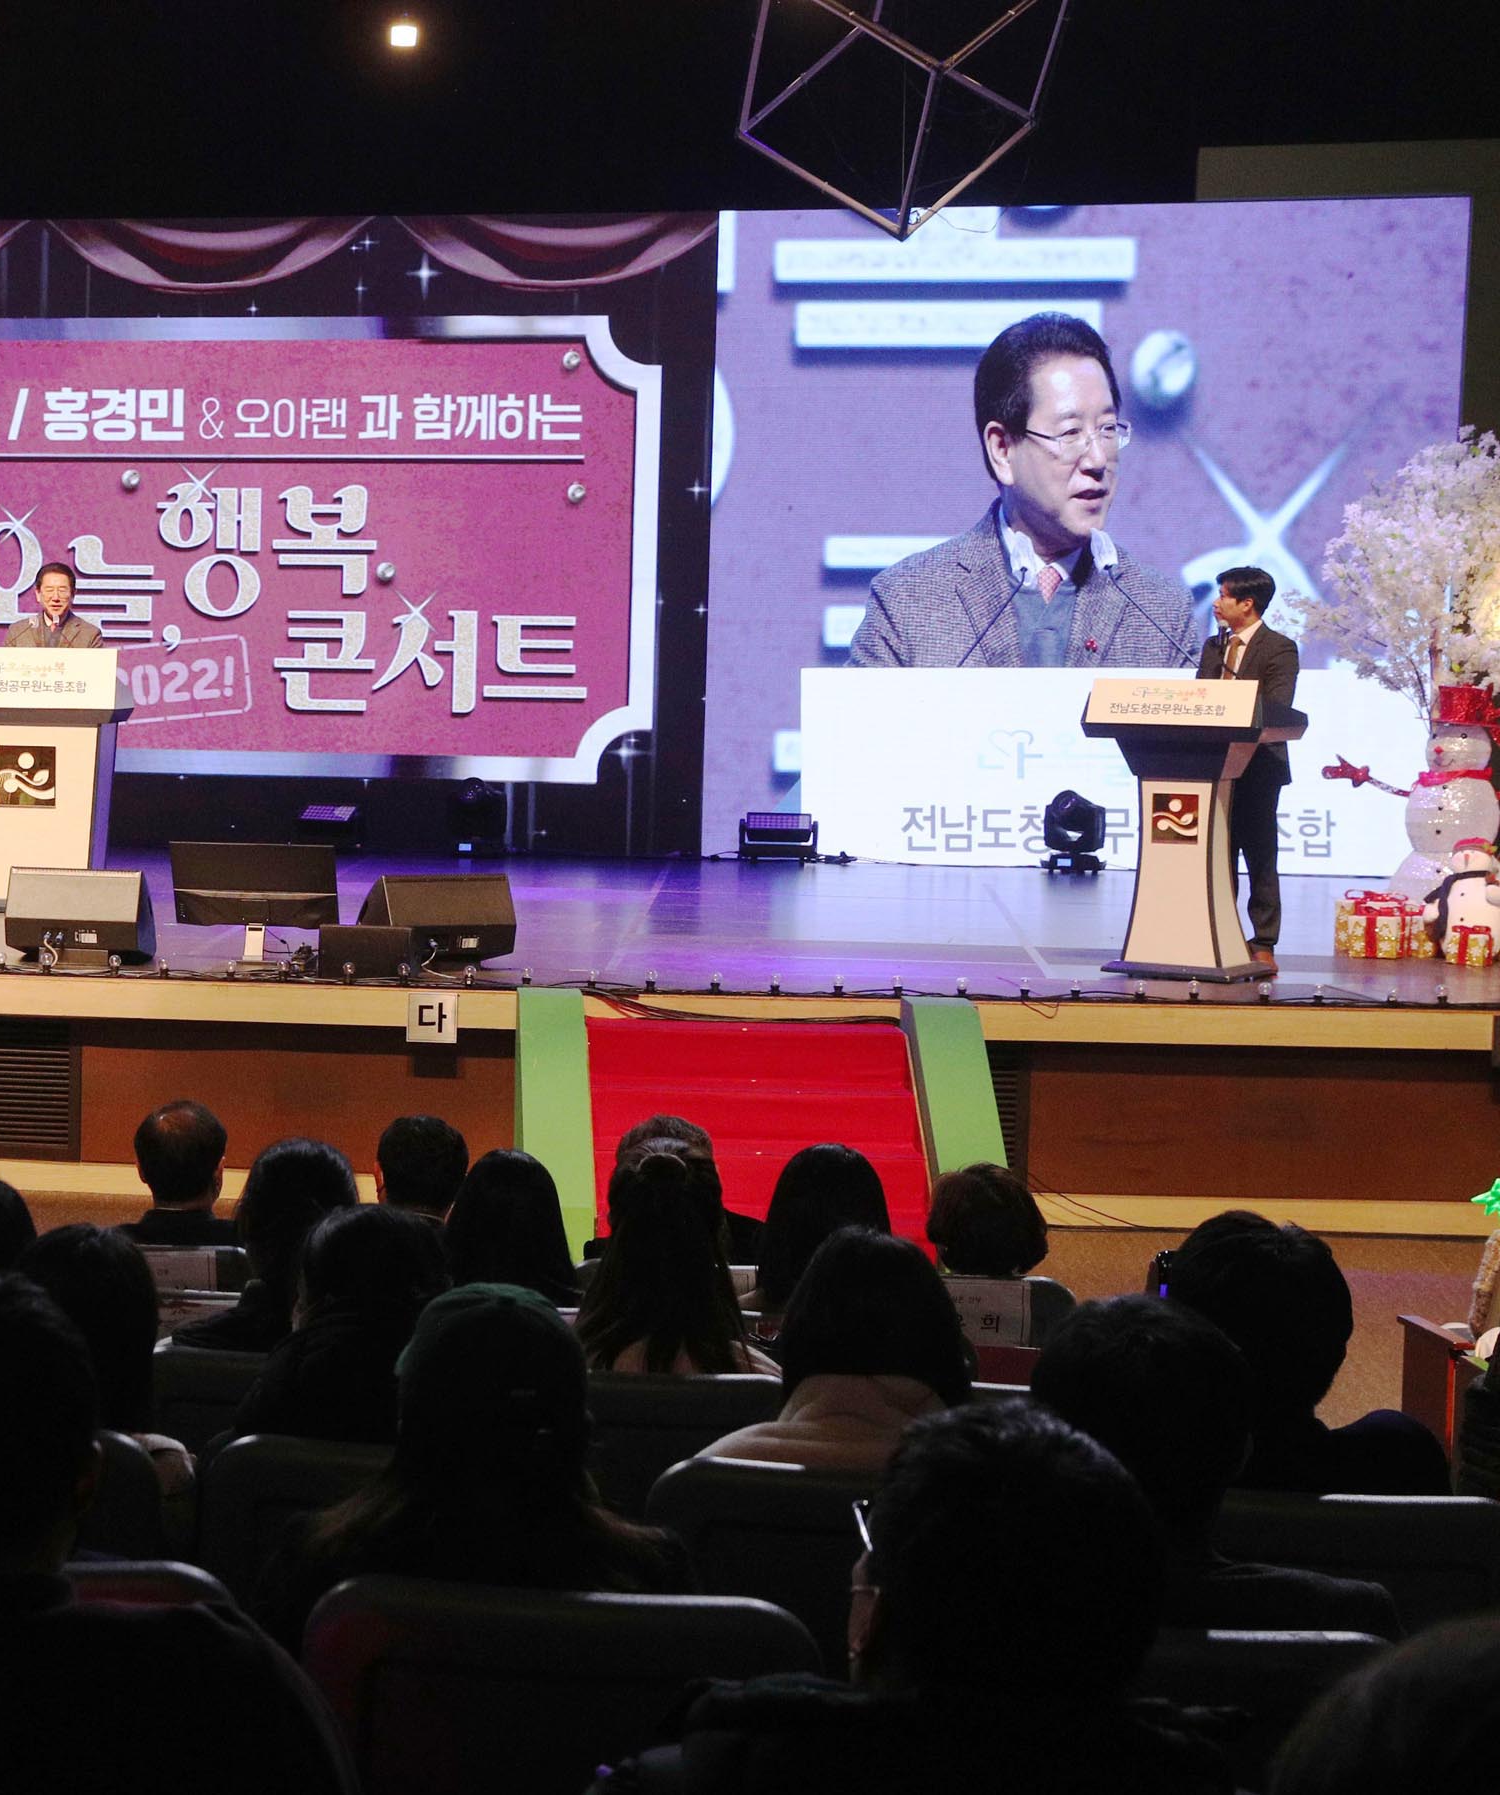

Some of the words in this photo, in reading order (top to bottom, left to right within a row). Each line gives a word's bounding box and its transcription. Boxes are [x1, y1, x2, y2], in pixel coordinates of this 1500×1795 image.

[7, 388, 29, 440] /
[43, 387, 184, 441] 홍경민
[199, 397, 225, 440] &
[234, 397, 347, 440] 오아랜
[357, 394, 402, 440] 과
[412, 393, 583, 441] 함께하는
[273, 610, 588, 715] 콘서트
[1109, 703, 1226, 717] 전남도청공무원노동조합
[418, 1002, 447, 1033] 다
